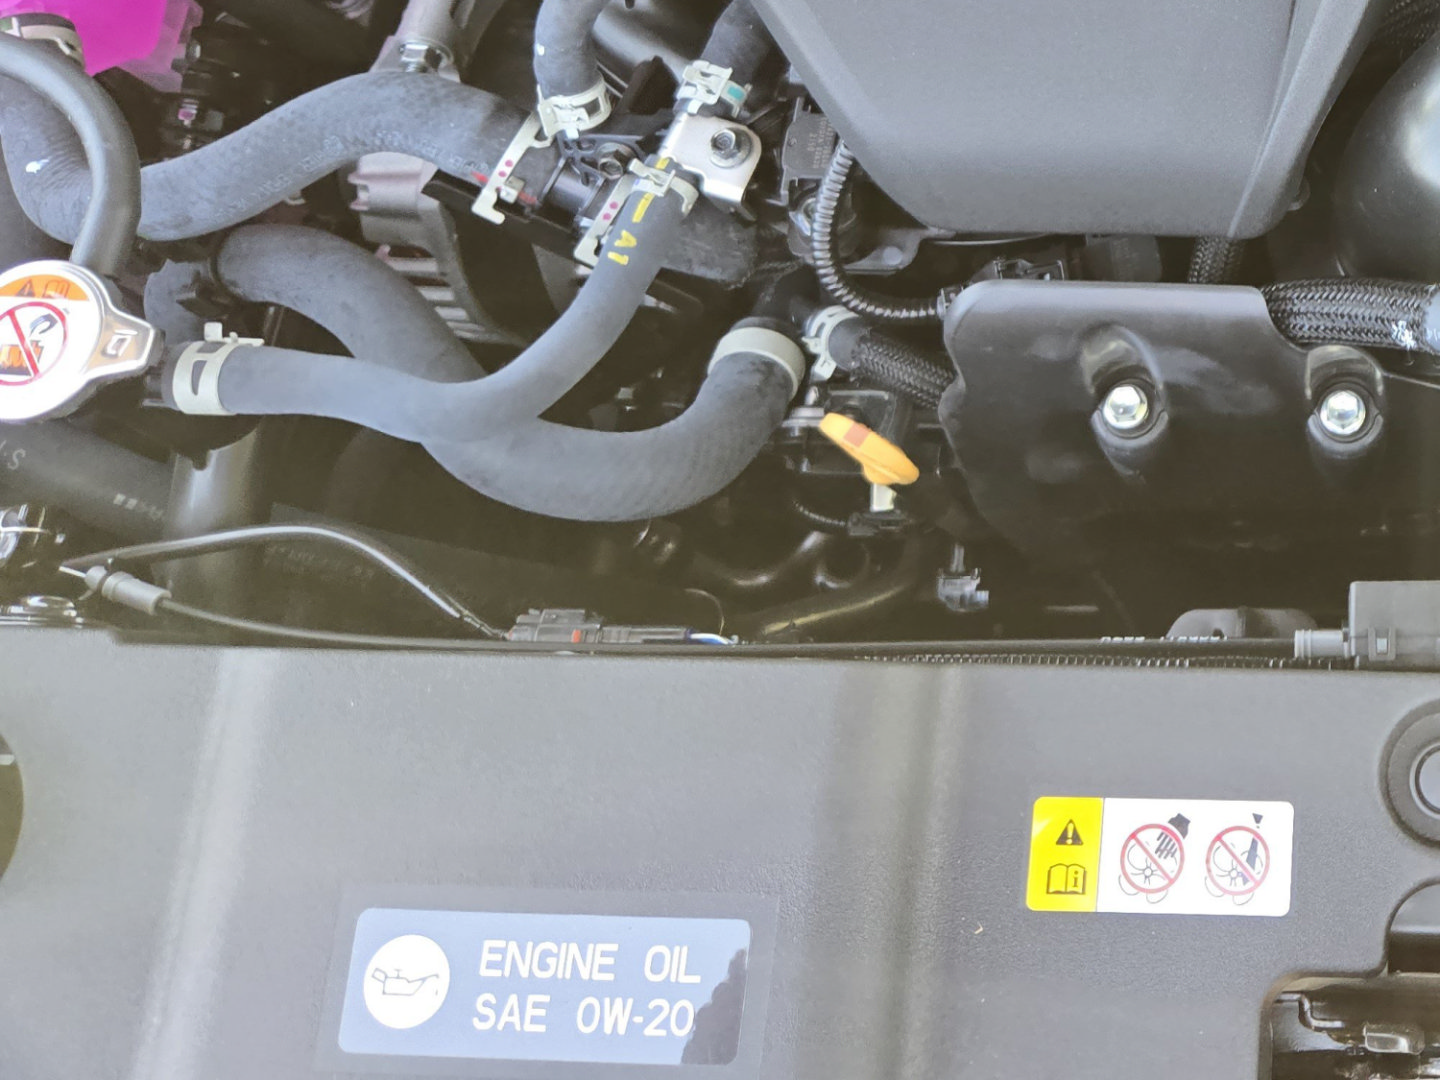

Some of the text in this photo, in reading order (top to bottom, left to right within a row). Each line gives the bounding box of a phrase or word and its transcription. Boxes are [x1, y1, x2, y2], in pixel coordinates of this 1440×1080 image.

[479, 940, 702, 985] ENGINE OIL
[473, 995, 696, 1037] SAE 0W-20
